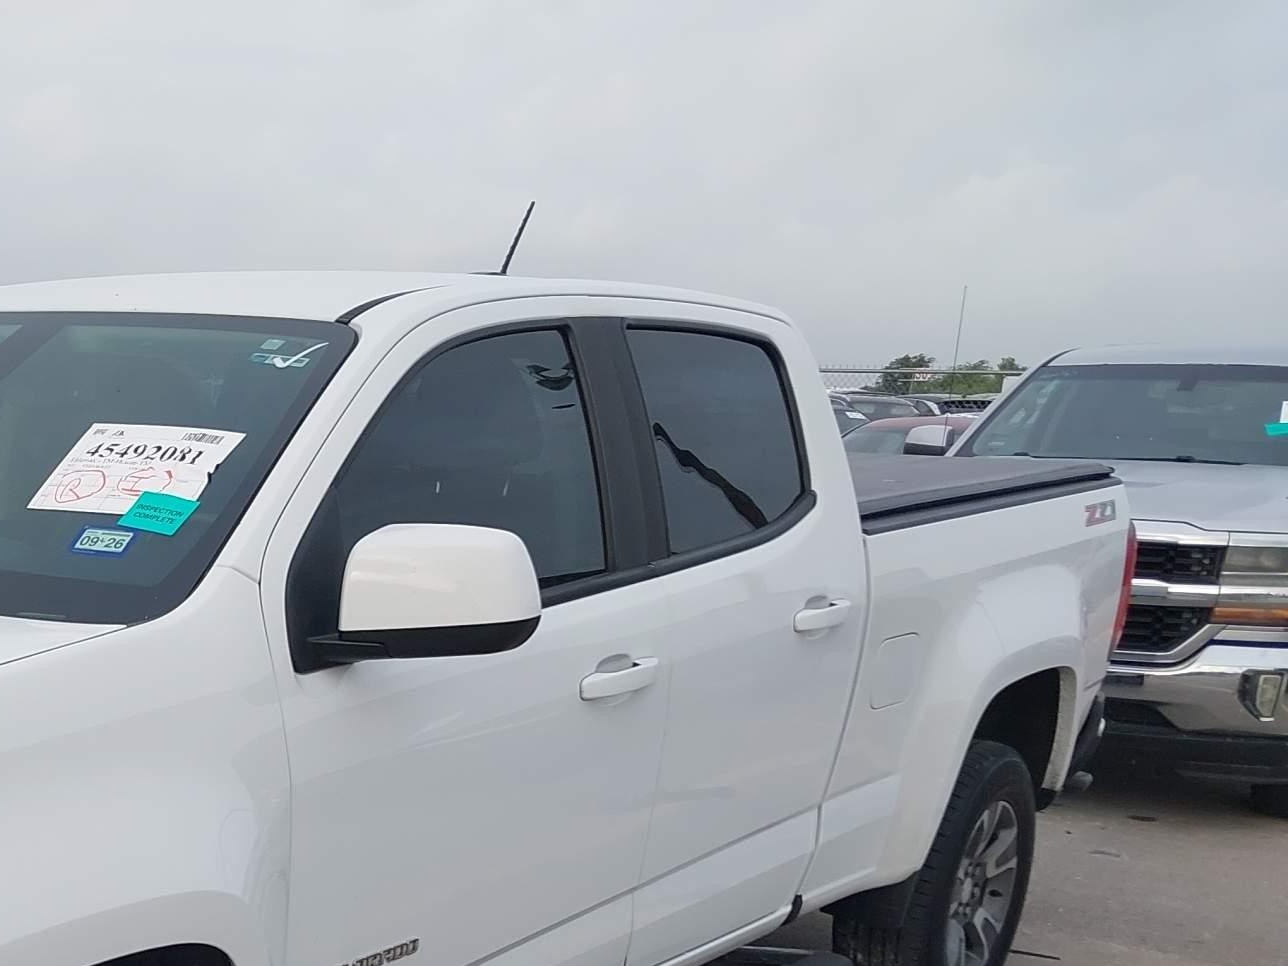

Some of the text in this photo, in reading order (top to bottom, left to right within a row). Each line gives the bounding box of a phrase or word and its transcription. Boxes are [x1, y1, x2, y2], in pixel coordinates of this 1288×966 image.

[86, 441, 206, 466] 45492081
[133, 510, 177, 524] COMPLETE
[135, 503, 186, 518] INSPECTION
[1085, 499, 1116, 528] Z71
